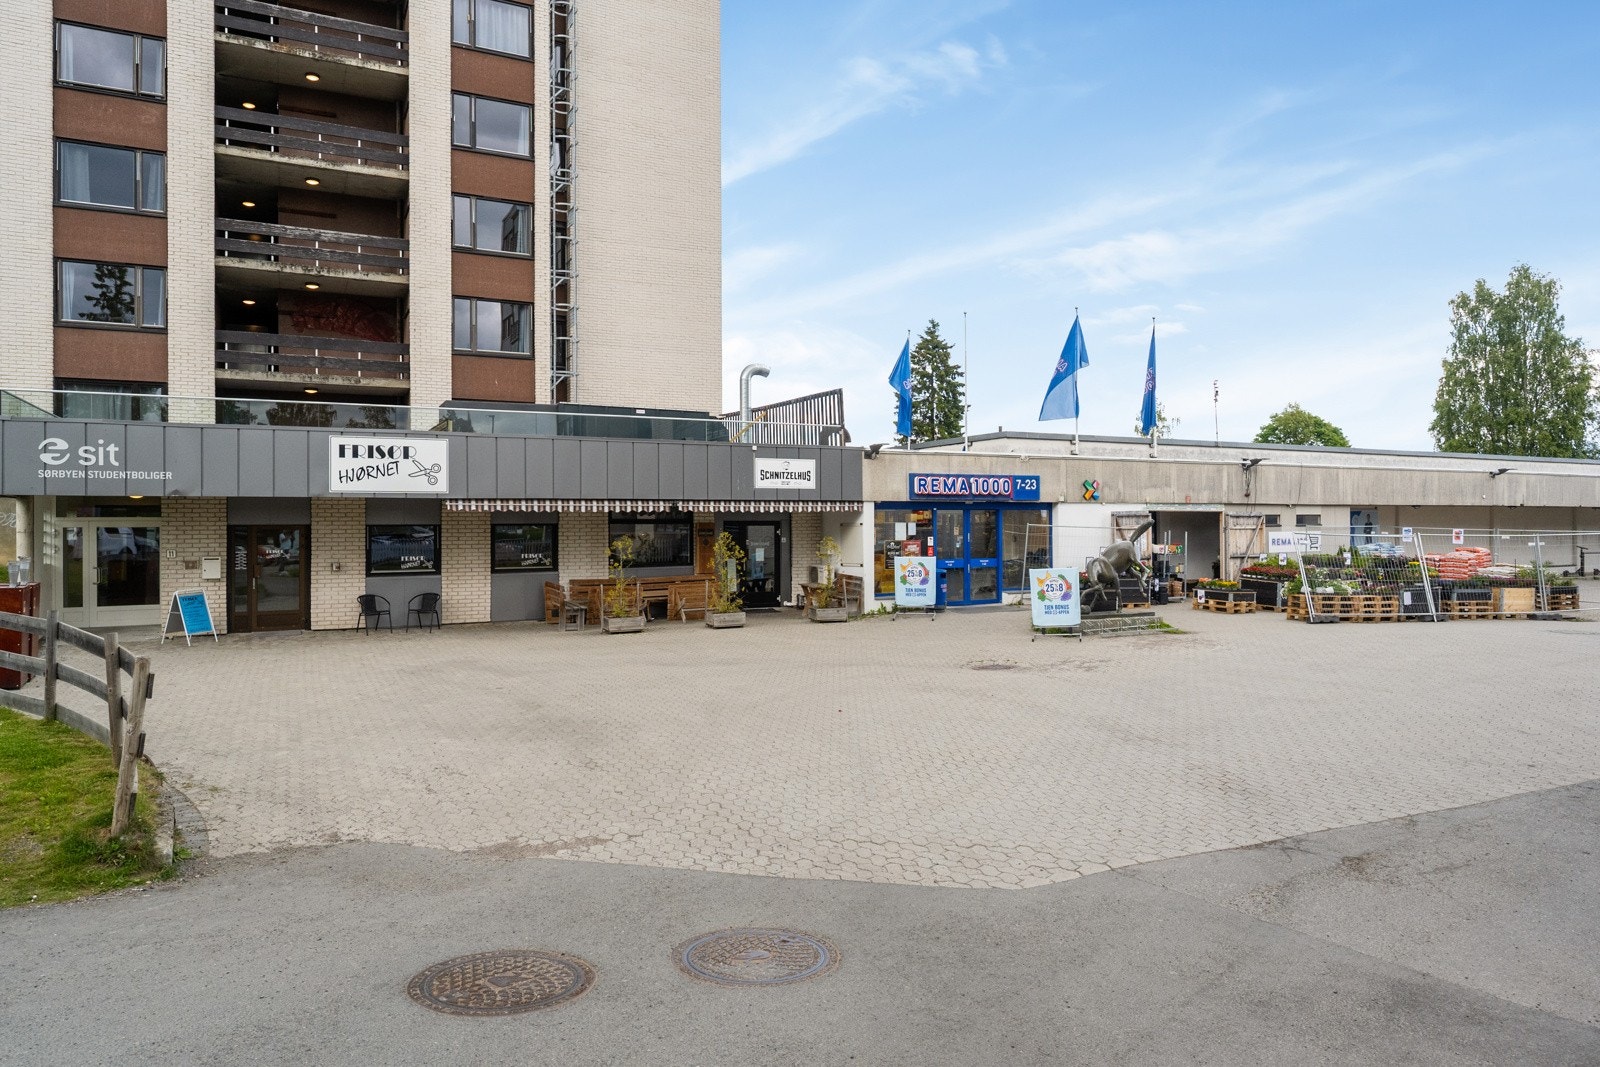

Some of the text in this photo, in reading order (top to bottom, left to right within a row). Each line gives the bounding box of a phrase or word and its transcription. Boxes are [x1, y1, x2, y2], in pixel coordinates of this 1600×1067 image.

[78, 439, 119, 466] sit
[339, 444, 417, 460] FRISØR
[38, 469, 173, 480] SØRBYEN STUDENTBOLIGER
[339, 461, 399, 484] HJØRNET
[760, 470, 811, 481] SCHNITZELHUS
[914, 476, 1011, 495] REMA 1000
[1016, 479, 1037, 490] 7-23
[1271, 538, 1292, 546] REMA
[1045, 583, 1055, 592] 25
[1058, 583, 1063, 591] 8
